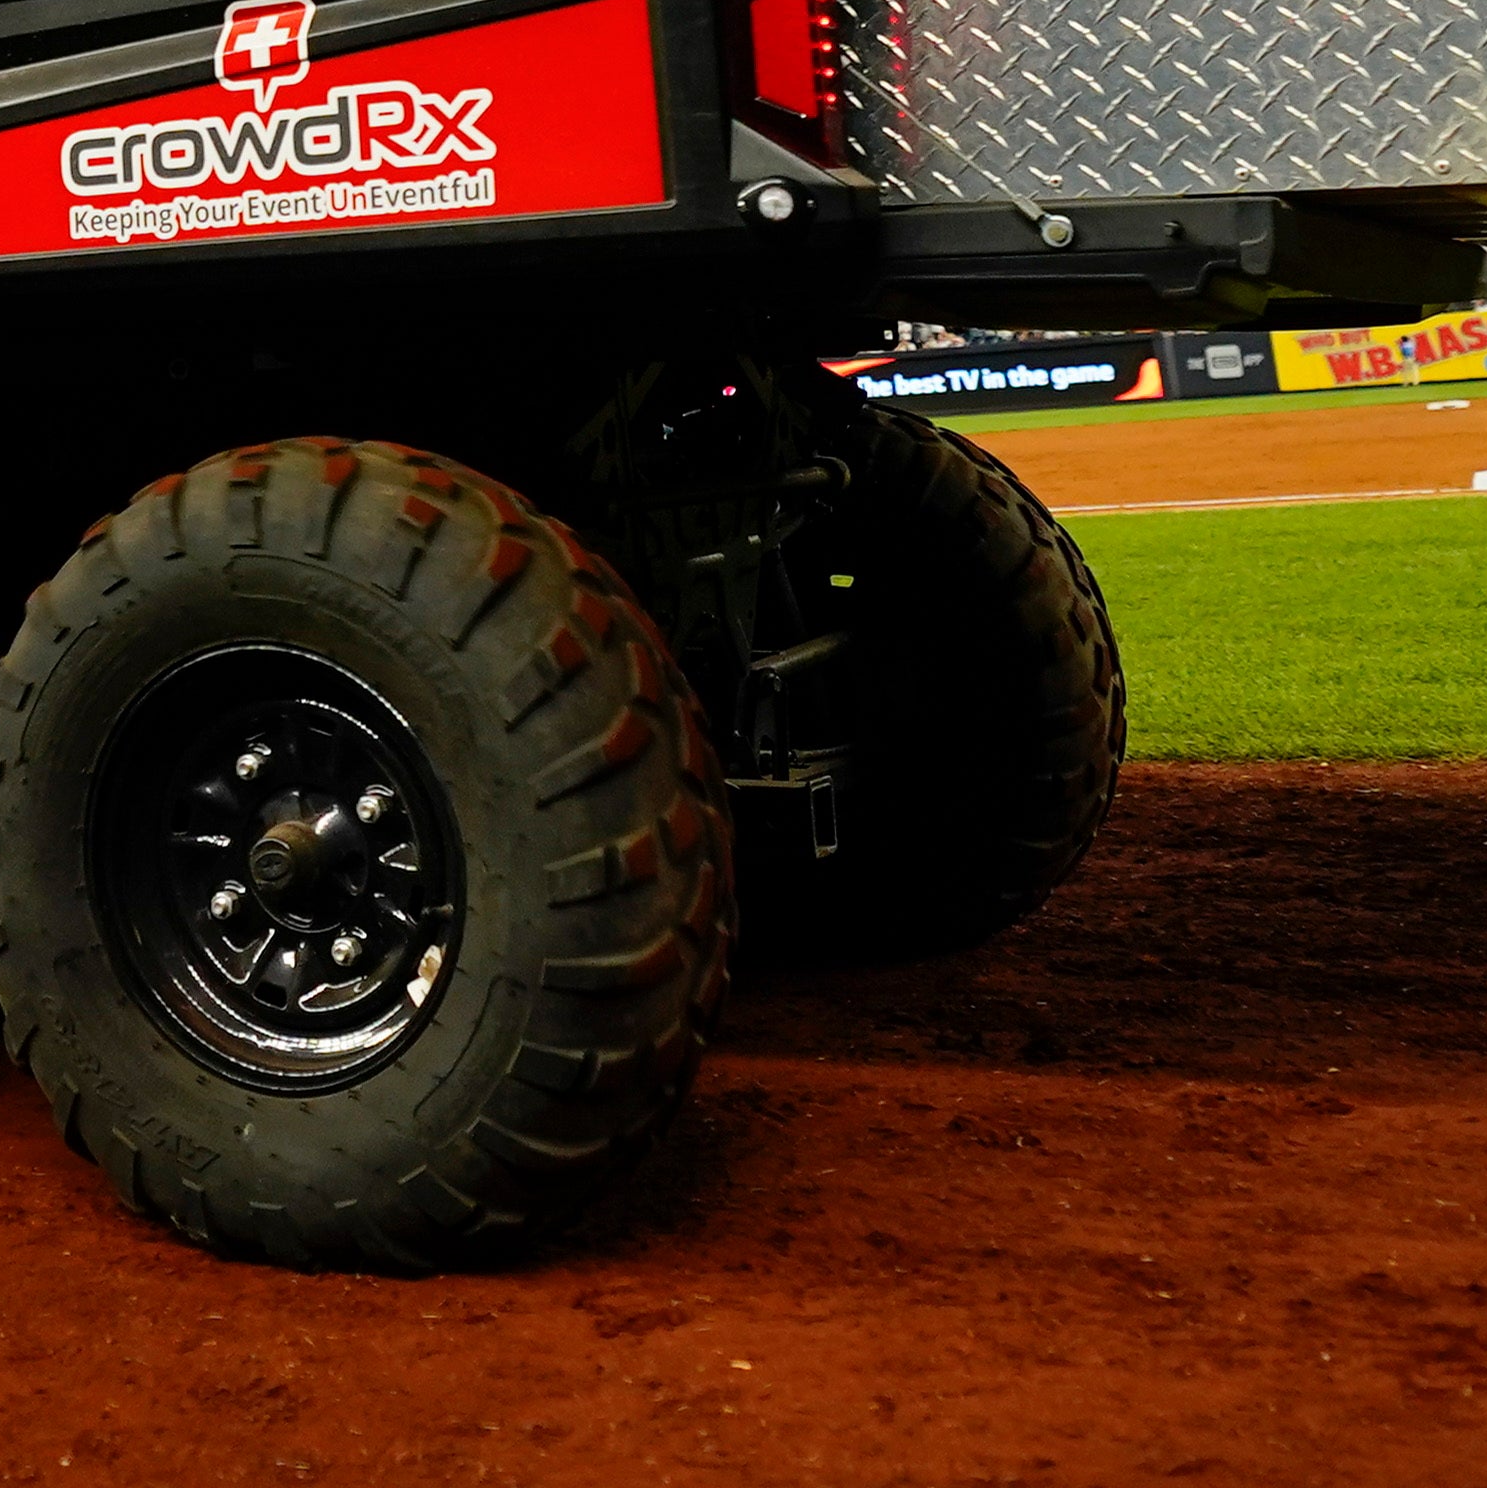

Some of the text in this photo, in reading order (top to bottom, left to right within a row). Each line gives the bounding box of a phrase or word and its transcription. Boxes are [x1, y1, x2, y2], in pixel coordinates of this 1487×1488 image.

[73, 175, 491, 237] Keeping Your Event UnEventful
[857, 364, 1116, 399] The best TV in the game
